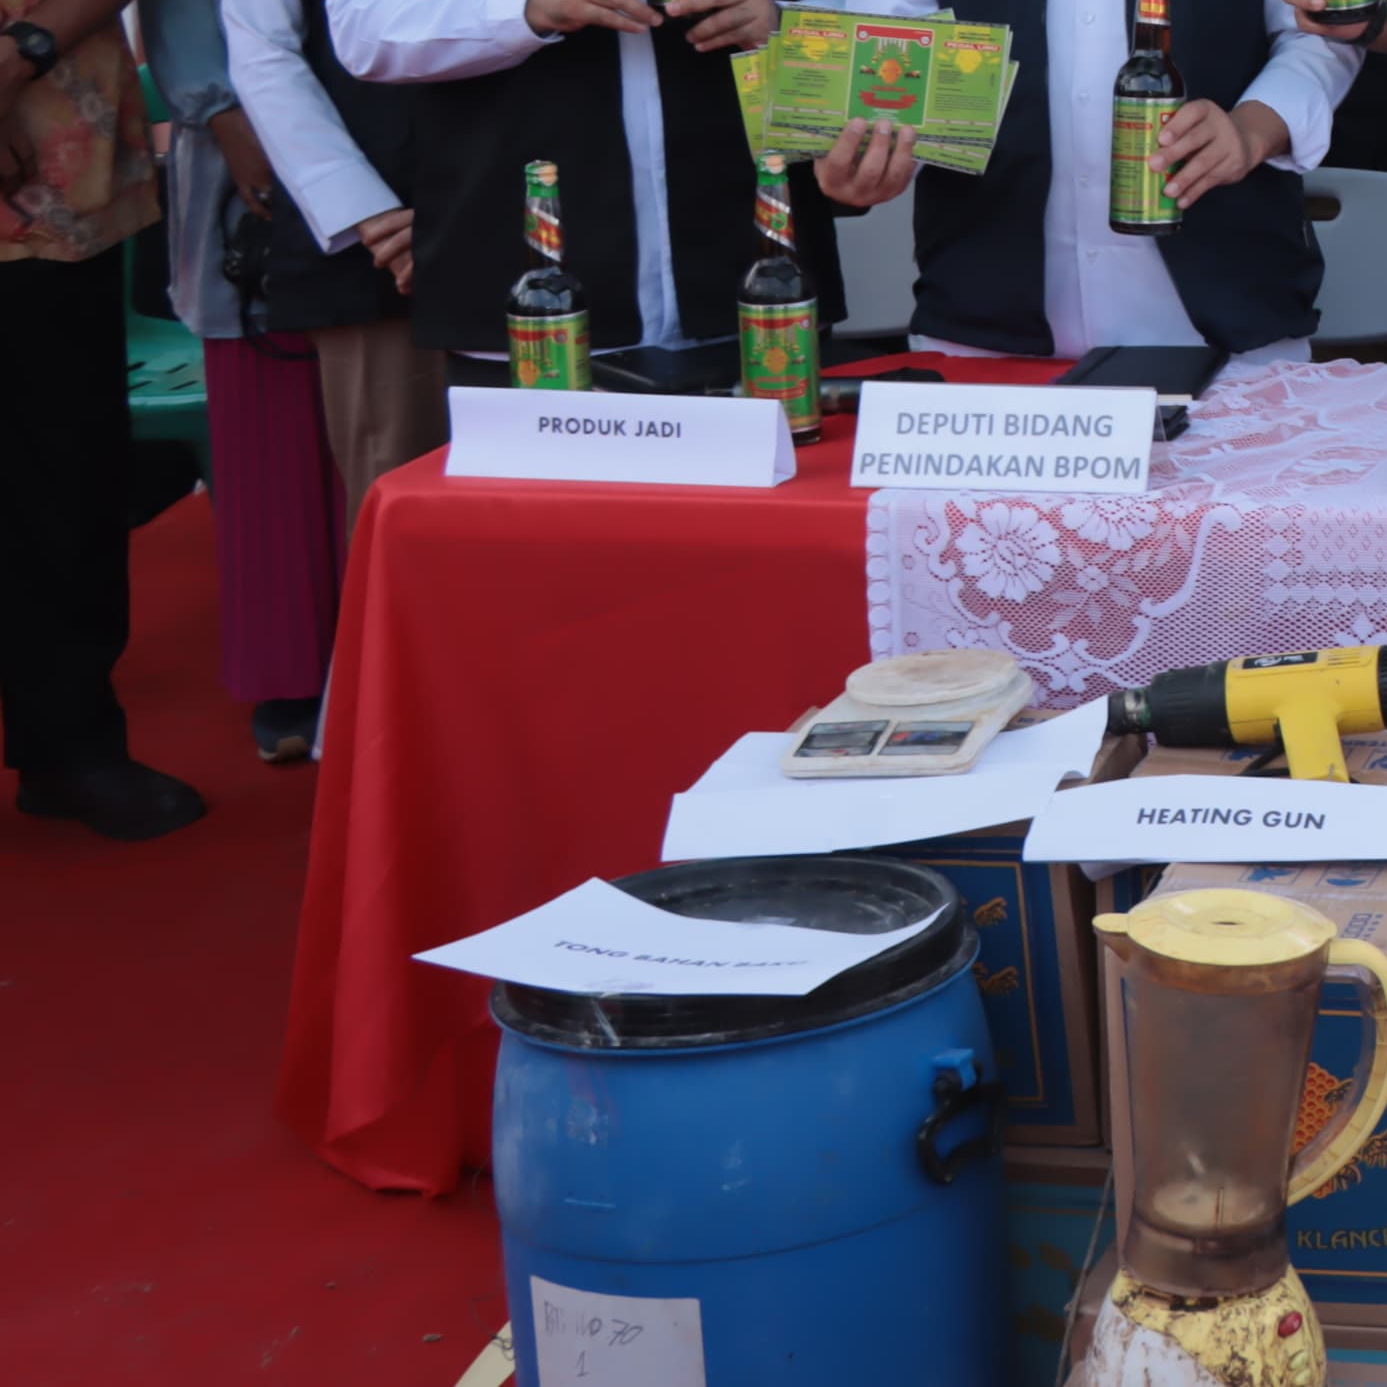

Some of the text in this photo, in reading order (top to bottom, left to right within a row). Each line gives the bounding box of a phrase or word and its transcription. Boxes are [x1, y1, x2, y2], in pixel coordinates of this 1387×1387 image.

[538, 416, 682, 440] PRODUK JADI
[896, 412, 1114, 439] DEPUTI BIDANG
[859, 453, 1142, 481] PENINDAKAN BPOM
[1137, 808, 1326, 830] HEATING GUN
[554, 939, 628, 958] TONG
[633, 955, 730, 968] BAHAN
